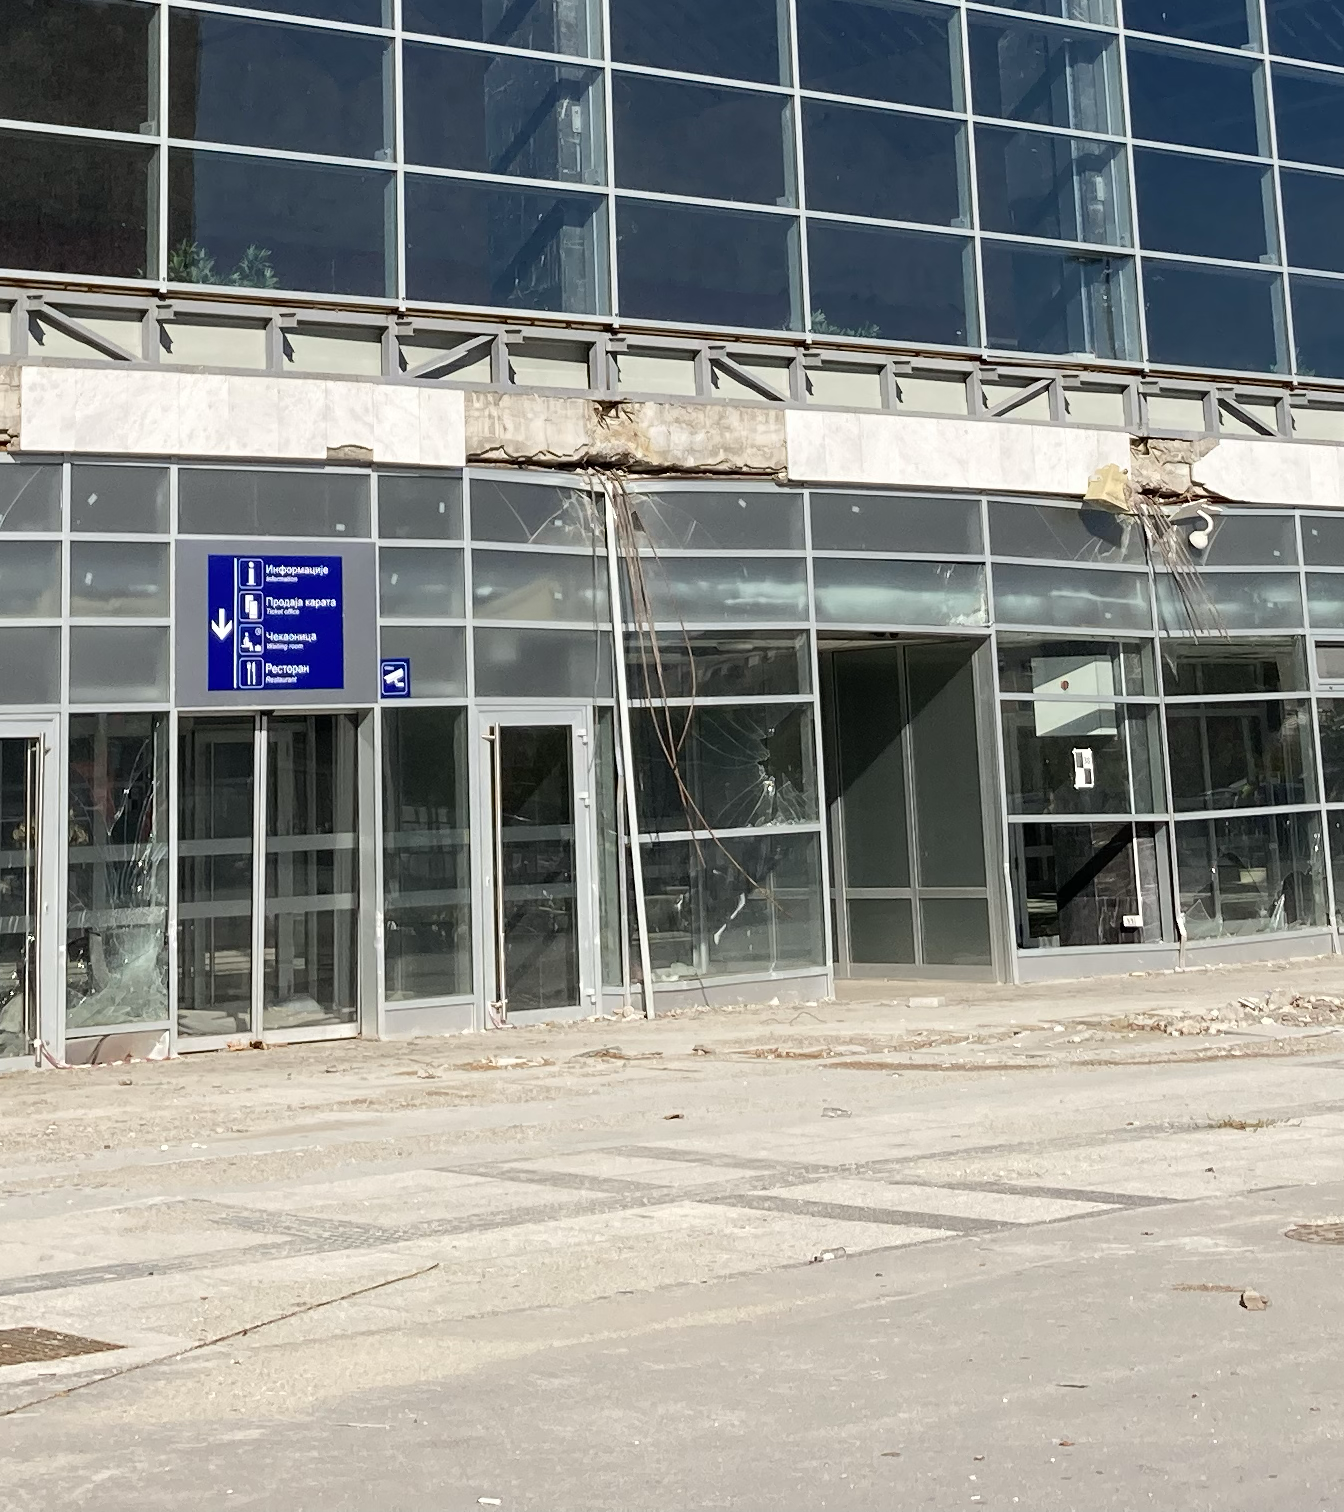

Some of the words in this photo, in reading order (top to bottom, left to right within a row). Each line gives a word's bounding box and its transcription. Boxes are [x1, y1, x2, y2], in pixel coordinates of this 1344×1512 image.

[266, 564, 328, 576] Информације
[266, 596, 303, 608] Продаја
[305, 598, 336, 609] карата
[266, 662, 309, 675] Ресторан
